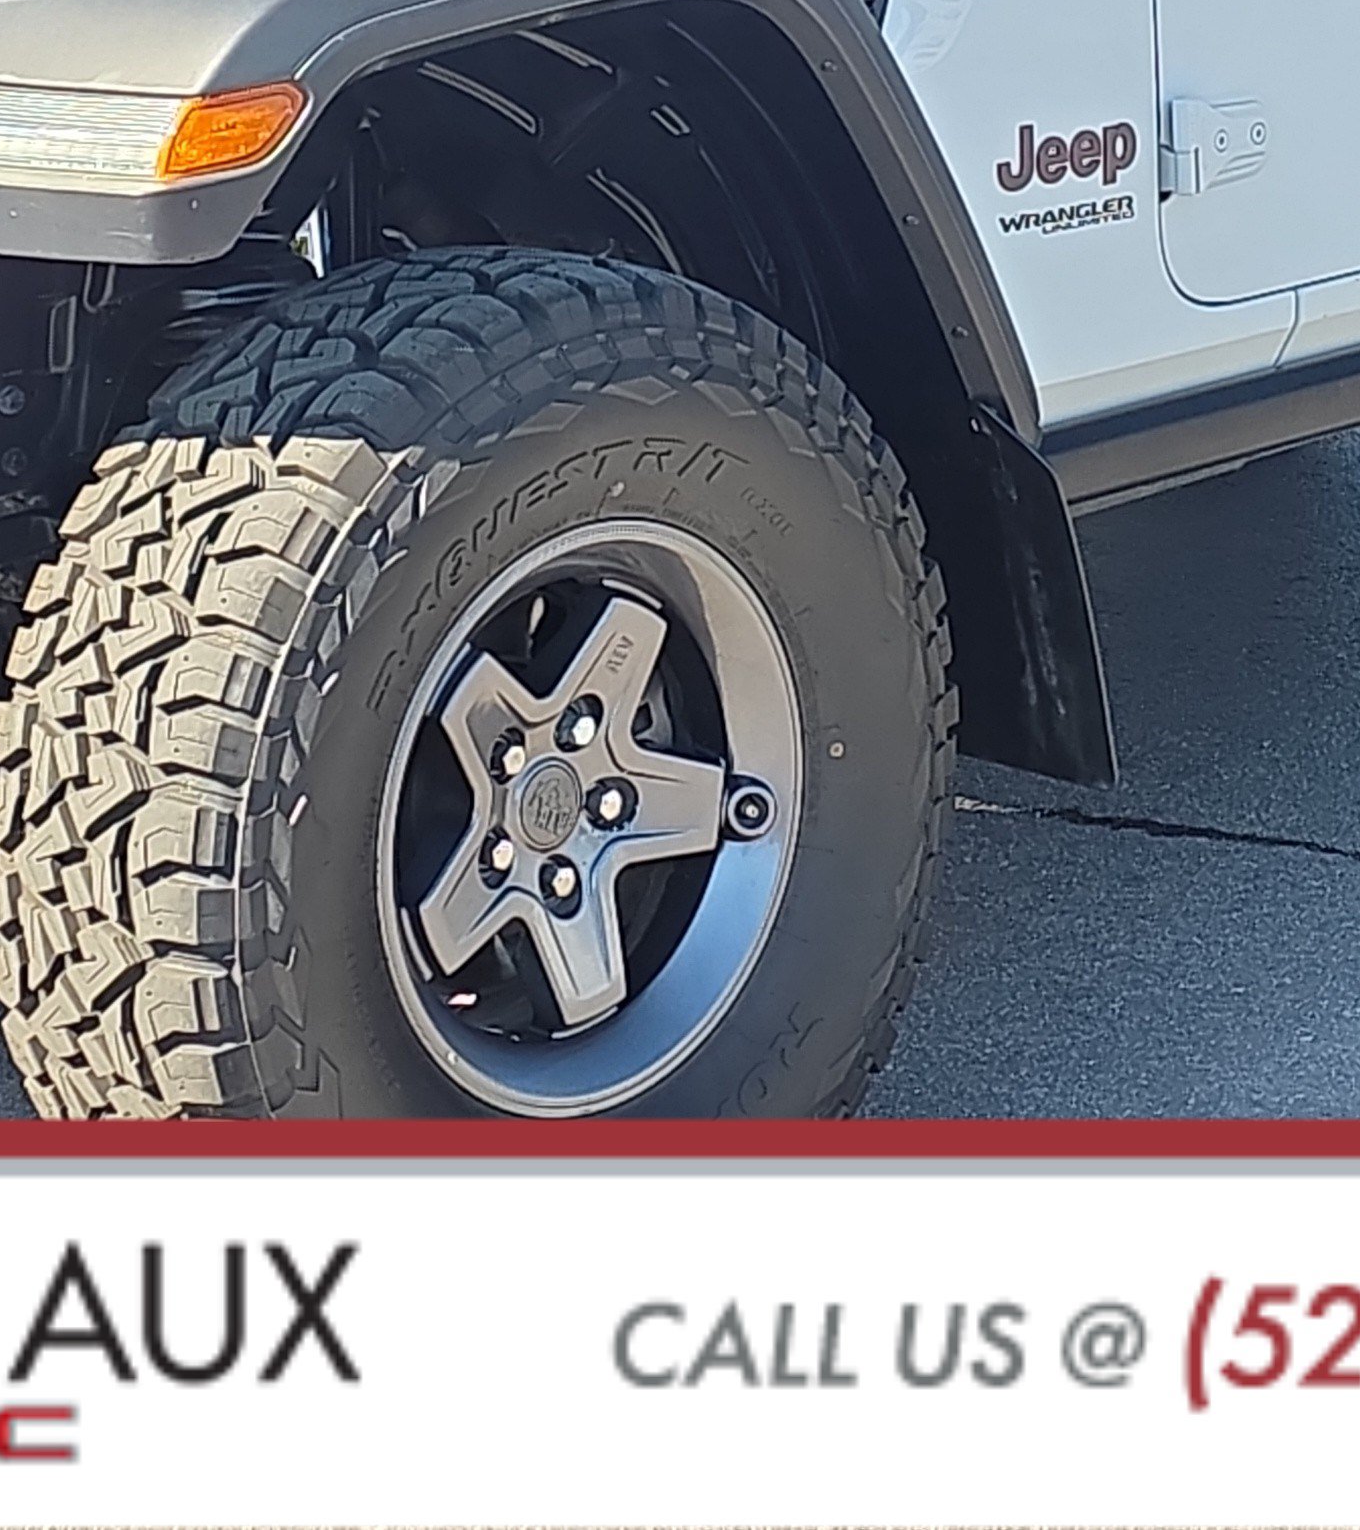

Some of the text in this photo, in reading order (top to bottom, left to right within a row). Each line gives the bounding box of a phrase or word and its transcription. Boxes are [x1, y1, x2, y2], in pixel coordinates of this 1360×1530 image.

[996, 121, 1137, 193] Jeep
[998, 195, 1135, 234] WRANGLER
[1041, 211, 1135, 235] UNLIMITED
